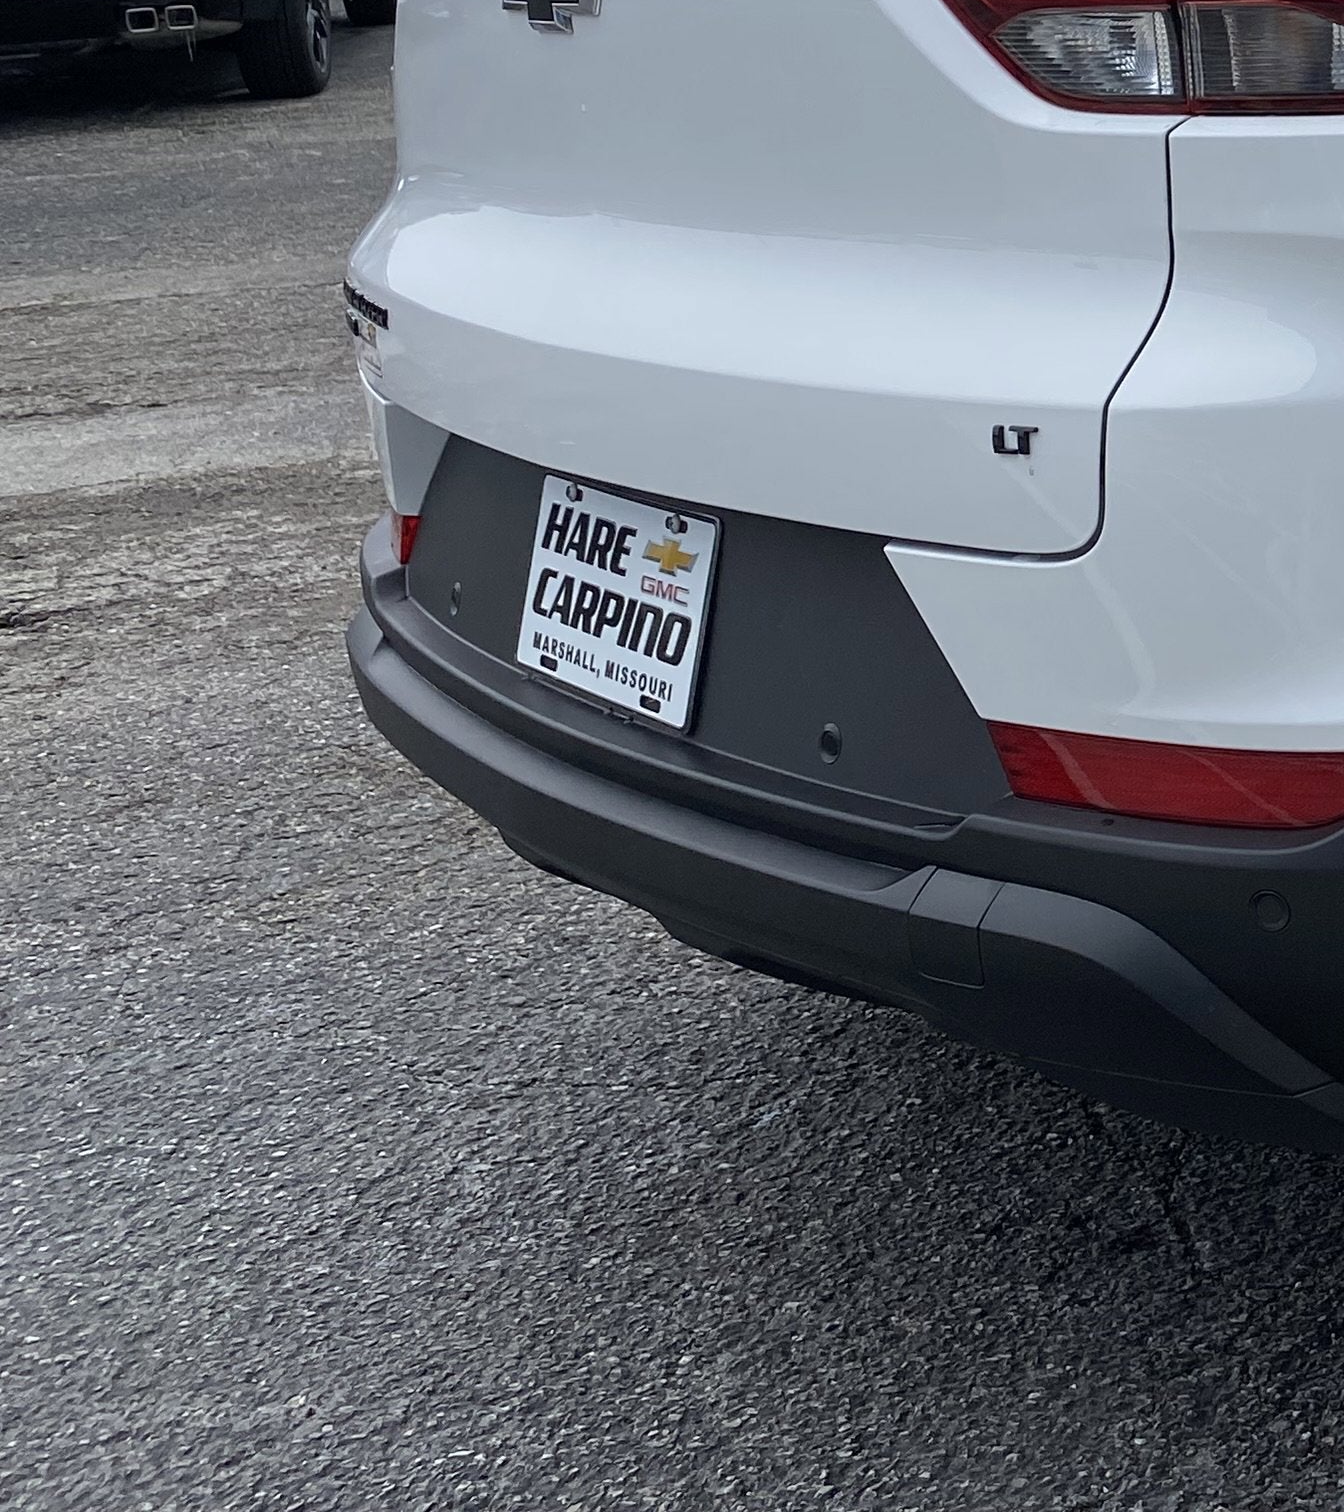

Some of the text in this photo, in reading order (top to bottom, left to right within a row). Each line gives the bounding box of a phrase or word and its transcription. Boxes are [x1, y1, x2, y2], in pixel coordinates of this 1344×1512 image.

[992, 424, 1039, 456] LT
[541, 502, 638, 577] HARE
[532, 567, 692, 667] CARPINO
[640, 575, 690, 607] GMC
[533, 631, 673, 702] MARSHALL, MISSOURI
